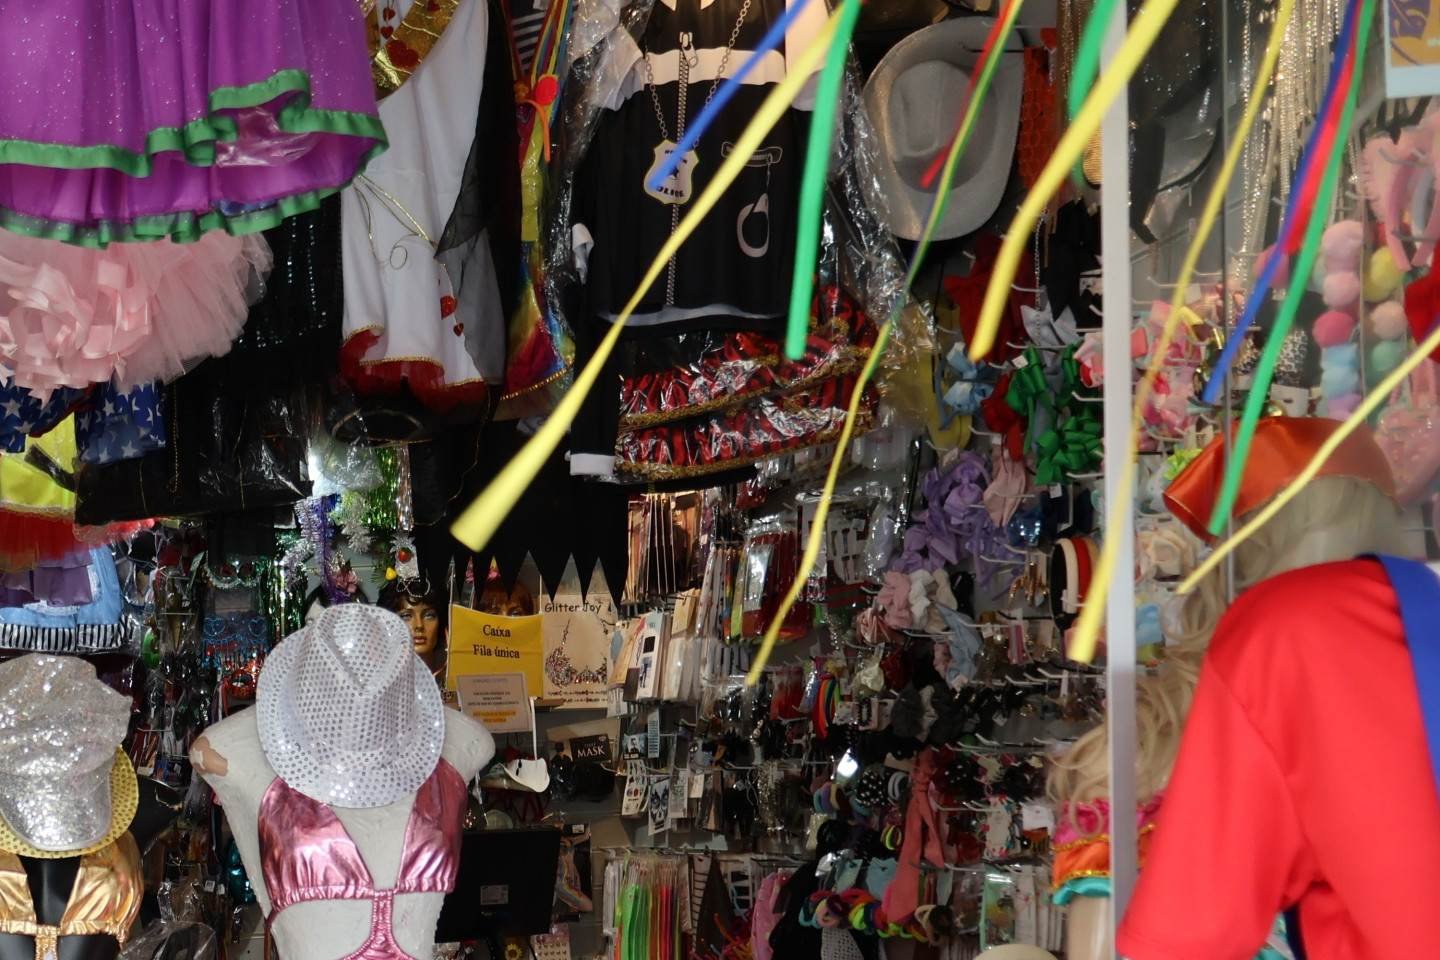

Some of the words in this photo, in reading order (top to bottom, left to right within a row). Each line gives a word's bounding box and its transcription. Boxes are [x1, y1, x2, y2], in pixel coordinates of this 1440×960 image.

[544, 601, 578, 613] Glitter
[583, 601, 602, 614] Joy
[472, 644, 492, 656] Fila
[494, 645, 520, 659] única
[577, 745, 606, 758] MASK
